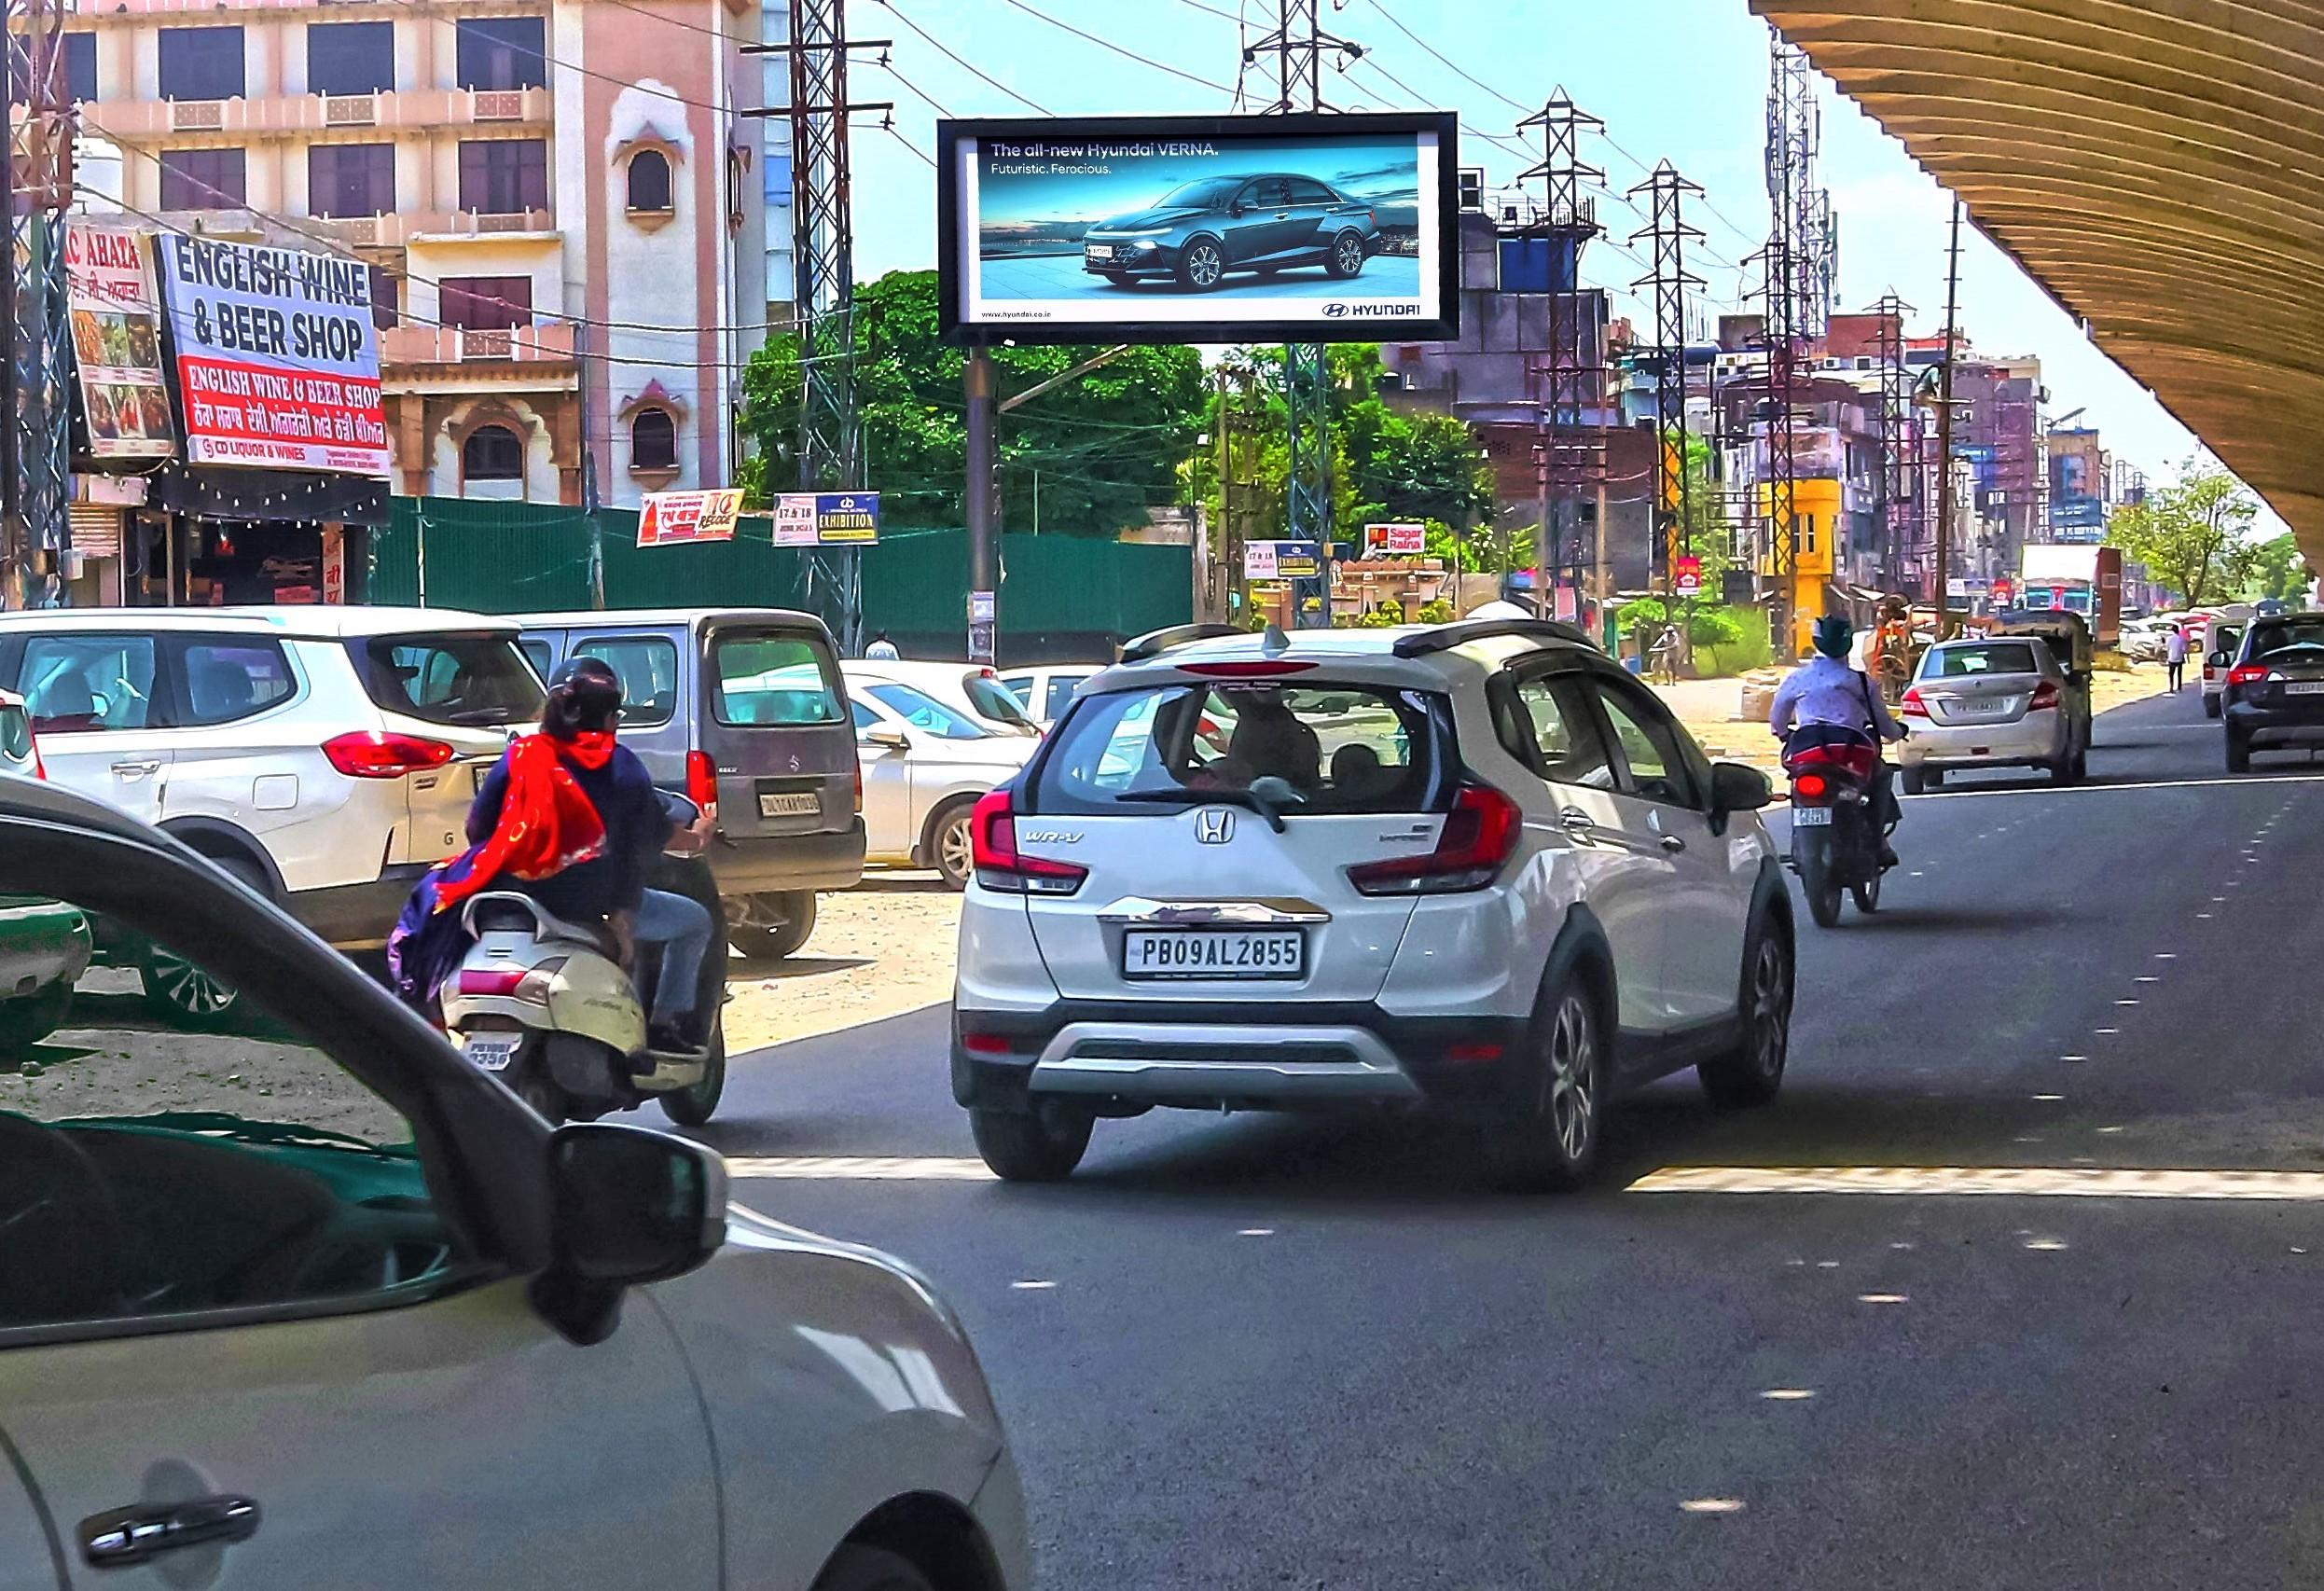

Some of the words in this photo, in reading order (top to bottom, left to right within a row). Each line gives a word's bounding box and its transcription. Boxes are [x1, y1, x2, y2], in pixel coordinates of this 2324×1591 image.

[991, 144, 1021, 157] The
[1024, 144, 1084, 157] all-new
[1087, 143, 1155, 159] Hyundai
[1157, 143, 1219, 157] VERNA.
[991, 163, 1049, 174] Futuristic.
[1051, 163, 1112, 174] Ferocious.
[87, 231, 141, 270] AHATA
[174, 235, 292, 297] ENGLISH
[297, 255, 368, 306] WINE
[1353, 304, 1420, 316] HYUNDAI
[194, 298, 213, 345] &
[216, 302, 288, 355] BEER
[294, 312, 362, 362] SHOP
[187, 365, 251, 395] ENGLISH
[251, 372, 292, 401] WINE
[306, 380, 343, 407] BEER
[345, 384, 380, 409] SHOP
[229, 442, 266, 458] LIQUOR
[274, 446, 306, 461] WINES
[819, 514, 873, 528] EXHIBITION
[1390, 528, 1422, 540] Sagar
[444, 832, 454, 845] G
[1025, 831, 1085, 844] WR-V
[1141, 938, 1298, 966] PB09AL2855
